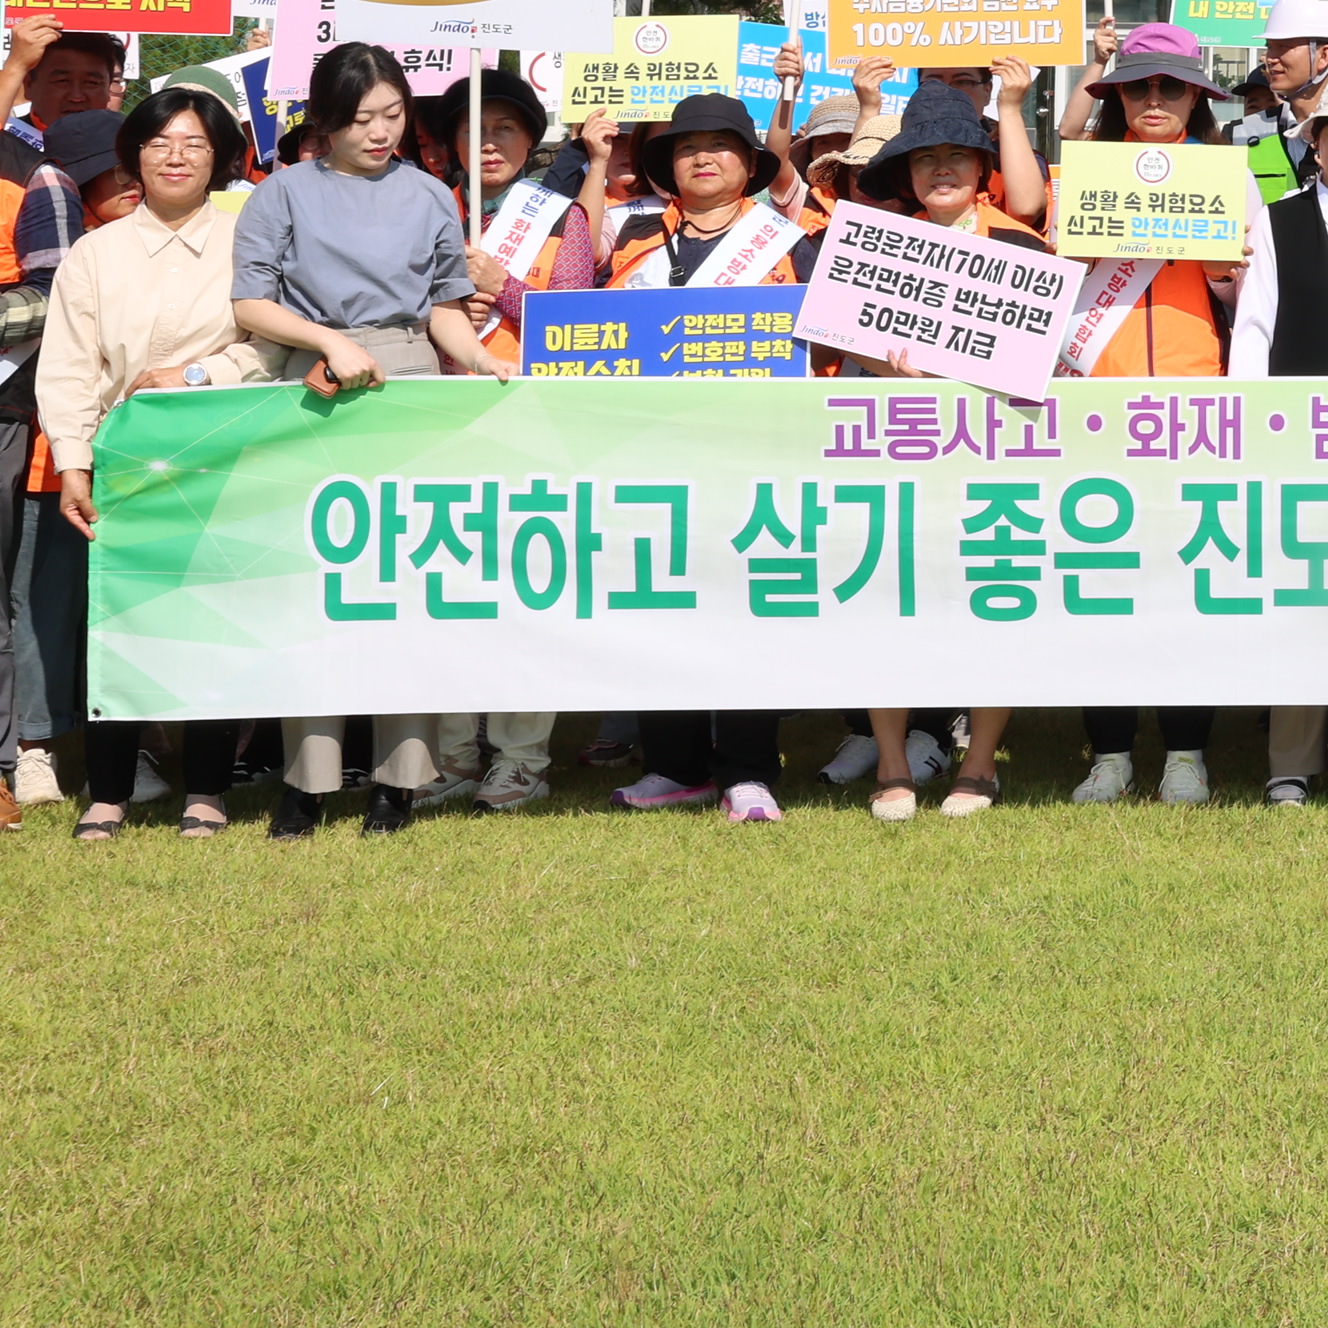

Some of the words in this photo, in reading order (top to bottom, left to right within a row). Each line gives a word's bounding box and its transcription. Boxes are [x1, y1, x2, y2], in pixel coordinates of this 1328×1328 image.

[1188, 0, 1210, 19] 내
[1214, 0, 1255, 20] 안전
[480, 23, 514, 36] 진도군
[851, 21, 933, 47] 100%
[938, 20, 1063, 46] 사기입니다
[583, 62, 619, 83] 생활
[624, 62, 640, 82] 속
[646, 61, 719, 82] 위험요소
[571, 85, 625, 105] 신고는
[1079, 190, 1118, 212] 생활
[1124, 191, 1141, 213] 속
[1148, 192, 1225, 215] 위험요소
[1067, 215, 1124, 237] 신고는
[1131, 217, 1237, 241] 안전신문고!
[838, 220, 1006, 285] 고령운전자(70세
[1011, 264, 1064, 301] 이상)
[827, 256, 948, 309] 운전면허증
[952, 288, 1053, 335] 반납하면
[544, 322, 629, 352] 이륜차
[683, 313, 746, 335] 안전모
[751, 312, 793, 334] 착용
[858, 301, 941, 346] 50만원
[948, 326, 997, 360] 지급
[682, 342, 745, 363] 번호판
[751, 339, 793, 361] 부착
[823, 394, 1062, 461] 교통사고
[1125, 394, 1242, 461] 화재
[311, 478, 697, 622] 안전하고
[731, 478, 917, 621] 살기
[958, 477, 1142, 622] 좋은
